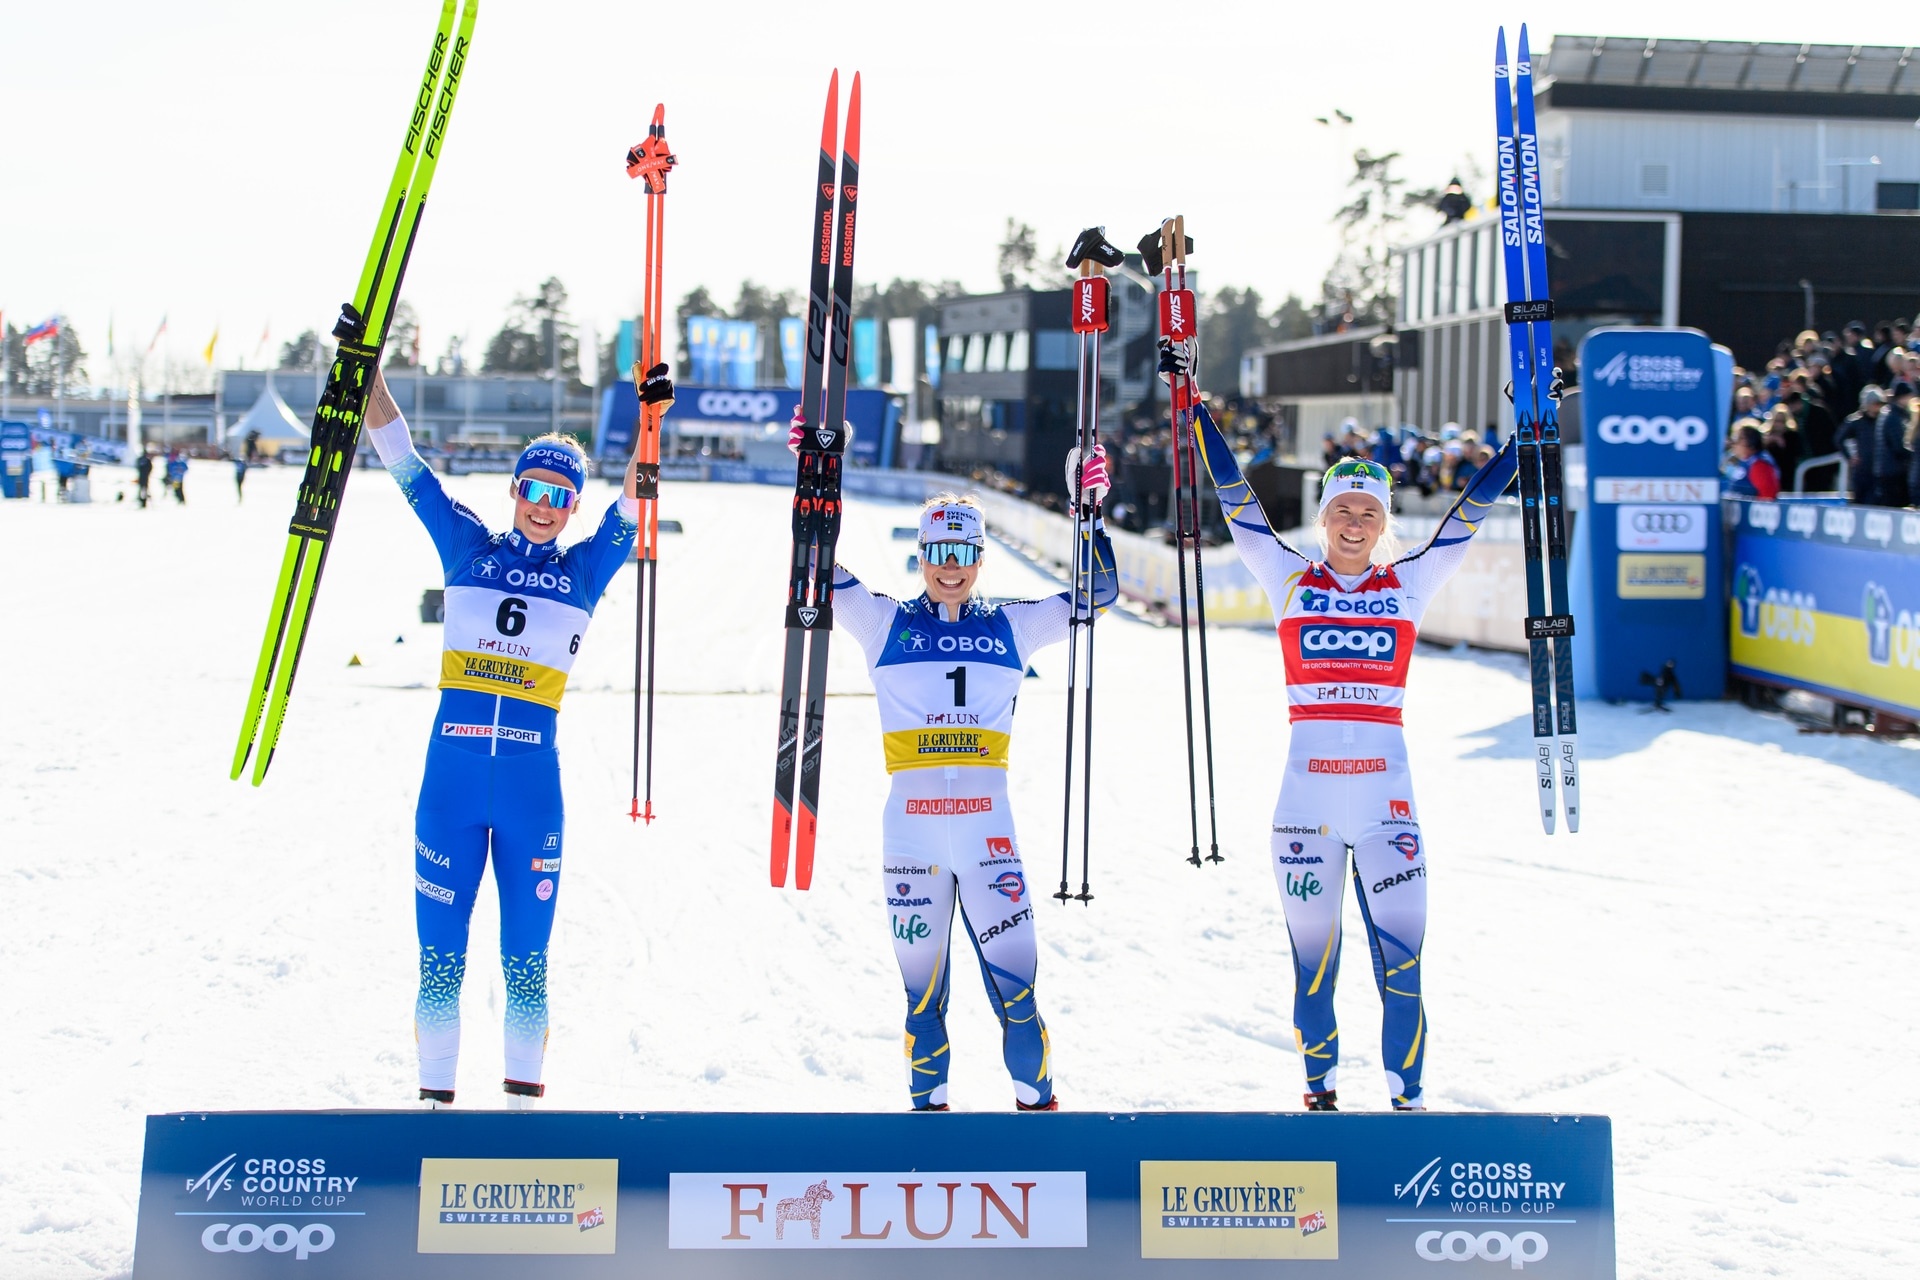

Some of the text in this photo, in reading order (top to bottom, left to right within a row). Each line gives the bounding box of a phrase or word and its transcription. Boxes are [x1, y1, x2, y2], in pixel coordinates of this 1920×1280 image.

[405, 31, 448, 156] FISCHER
[425, 36, 469, 160] FISCHER
[1498, 136, 1521, 247] SALOMON
[1520, 133, 1543, 245] SALOMON
[820, 208, 832, 265] ROSSIGNOL
[843, 210, 855, 267] ROSSIGNOL
[338, 345, 376, 358] FISCHER
[698, 390, 779, 422] coop
[1597, 415, 1709, 451] coop
[526, 448, 581, 473] gorenje
[946, 510, 977, 522] SVENSKA
[290, 522, 328, 536] FISCHER
[506, 568, 572, 594] OBOS
[1335, 597, 1399, 615] OBOS
[495, 597, 528, 637] 6
[477, 638, 531, 658] FLUN
[569, 634, 580, 655] 6
[937, 636, 1007, 655] OBOS
[1303, 629, 1393, 657] coop
[465, 657, 477, 671] LE
[466, 670, 521, 684] SWITZERLAND
[946, 666, 966, 707] 1
[1317, 687, 1379, 701] FLUN
[925, 713, 979, 725] FLUN
[918, 734, 929, 747] LE
[1309, 759, 1386, 774] BAUHAUS
[906, 798, 992, 814] BAUHAUS
[979, 858, 1013, 868] SVENSKA
[1279, 856, 1324, 865] SCANIA
[988, 880, 1019, 890] Thermia
[1286, 871, 1323, 902] life
[1372, 867, 1422, 894] CRAFT
[887, 897, 932, 907] SCANIA
[892, 914, 931, 945] life
[979, 909, 1030, 945] CRAFT
[244, 1158, 326, 1175] CROSS
[1450, 1162, 1532, 1180] CROSS
[243, 1176, 359, 1193] COUNTRY
[1450, 1182, 1566, 1199] COUNTRY
[241, 1195, 346, 1207] WORLD CUP
[440, 1183, 467, 1209] LE
[1161, 1186, 1188, 1212] LE
[721, 1179, 1037, 1241] FLUN
[1450, 1202, 1556, 1214] WORLD CUP
[445, 1213, 568, 1223] SWITZERLAND
[1168, 1217, 1290, 1227] SWITZERLAND
[201, 1223, 336, 1260] coop
[1415, 1230, 1549, 1270] coop
